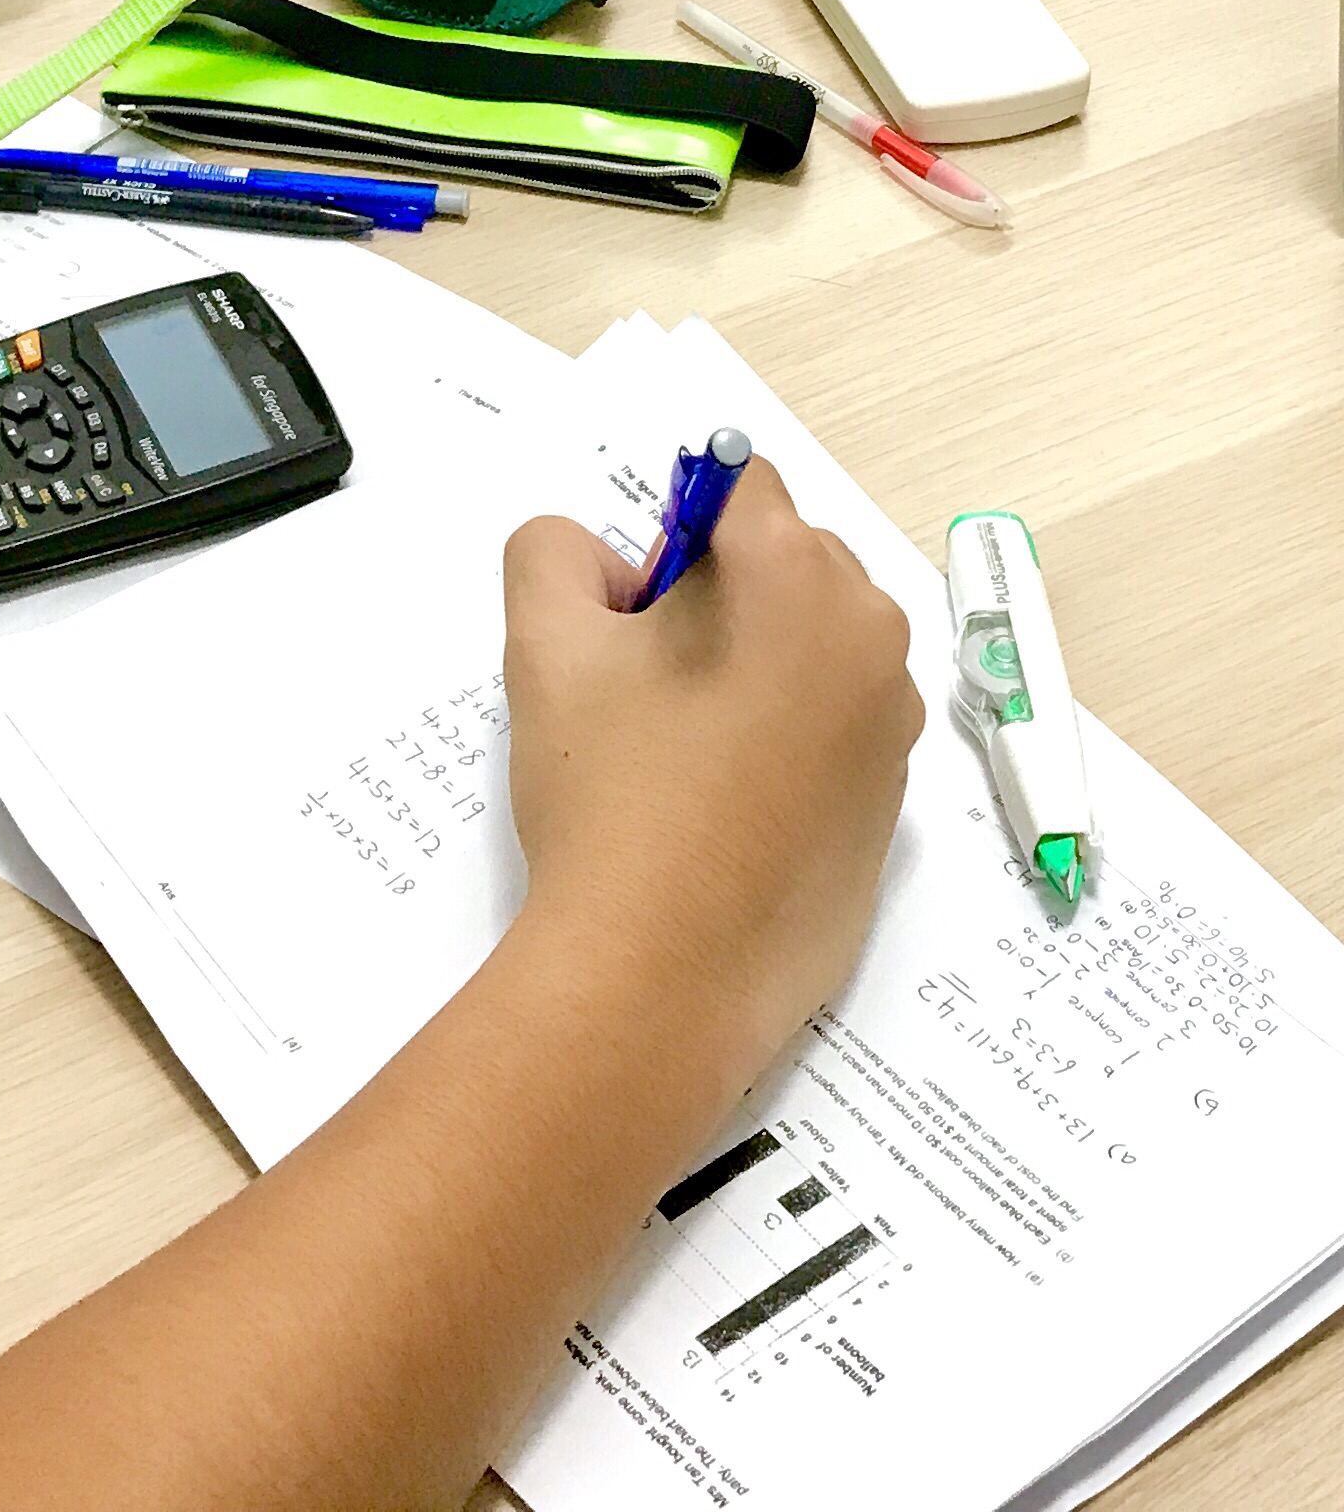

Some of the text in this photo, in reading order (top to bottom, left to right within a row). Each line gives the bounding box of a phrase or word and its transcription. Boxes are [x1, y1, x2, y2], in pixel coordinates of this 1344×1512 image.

[123, 179, 156, 189] CLICK
[172, 240, 203, 259] between
[211, 287, 245, 332] SHARP
[49, 362, 67, 379] D1
[70, 383, 88, 402] D2
[250, 373, 297, 441] for Singapore
[472, 396, 501, 414] figures
[85, 410, 102, 428] D3
[91, 439, 109, 458] D4
[138, 435, 170, 482] WriteView
[597, 444, 659, 504] 9 The figure
[52, 477, 73, 504] MODE
[607, 472, 644, 504] rectangle.
[990, 572, 1011, 604] PLUS
[158, 882, 176, 901] Ans
[1067, 995, 1123, 1044] compare
[807, 1018, 842, 1049] yellow
[843, 1028, 885, 1068] balloons
[841, 1051, 867, 1075] each
[865, 1073, 889, 1097] than
[883, 1065, 907, 1089] blue
[905, 1086, 921, 1101] on
[846, 1107, 869, 1127] buy
[887, 1094, 915, 1121] more
[799, 1119, 836, 1154] Colour
[866, 1124, 887, 1147] Tan
[951, 1132, 966, 1144] of
[887, 1145, 909, 1167] Mrs
[922, 1077, 1085, 1222] Find the cost of each blue balloon
[939, 1145, 963, 1167] cost
[963, 1143, 1005, 1178] amount
[775, 1119, 897, 1238] Pink Yellow Red
[904, 1163, 925, 1180] did
[961, 1166, 1001, 1202] balloon
[1001, 1178, 1029, 1201] total
[923, 1179, 968, 1221] balloons
[999, 1199, 1024, 1222] blue
[763, 1212, 783, 1231] 3
[965, 1218, 997, 1245] many
[1035, 1206, 1068, 1233] spent
[1022, 1219, 1052, 1246] Each
[902, 1263, 913, 1272] 0
[994, 1244, 1021, 1267] How
[1055, 1248, 1075, 1264] (b)
[877, 1279, 890, 1290] 2
[1024, 1270, 1045, 1287] (a)
[851, 1297, 863, 1306] 4
[826, 1315, 838, 1325] 6
[591, 1339, 611, 1360] the
[800, 1332, 813, 1343] 8
[773, 1351, 790, 1366] 10
[814, 1341, 877, 1398] Number of
[837, 1336, 886, 1383] balloons
[594, 1369, 621, 1396] pink,
[607, 1357, 641, 1391] shows
[747, 1369, 763, 1385] 12
[637, 1390, 671, 1423] below
[720, 1388, 736, 1403] 14
[617, 1396, 648, 1426] some
[665, 1418, 697, 1447] chart
[645, 1426, 685, 1465] bought
[694, 1445, 717, 1469] The
[684, 1462, 706, 1487] Tan
[717, 1465, 750, 1496] party.
[706, 1485, 729, 1509] Mrs
